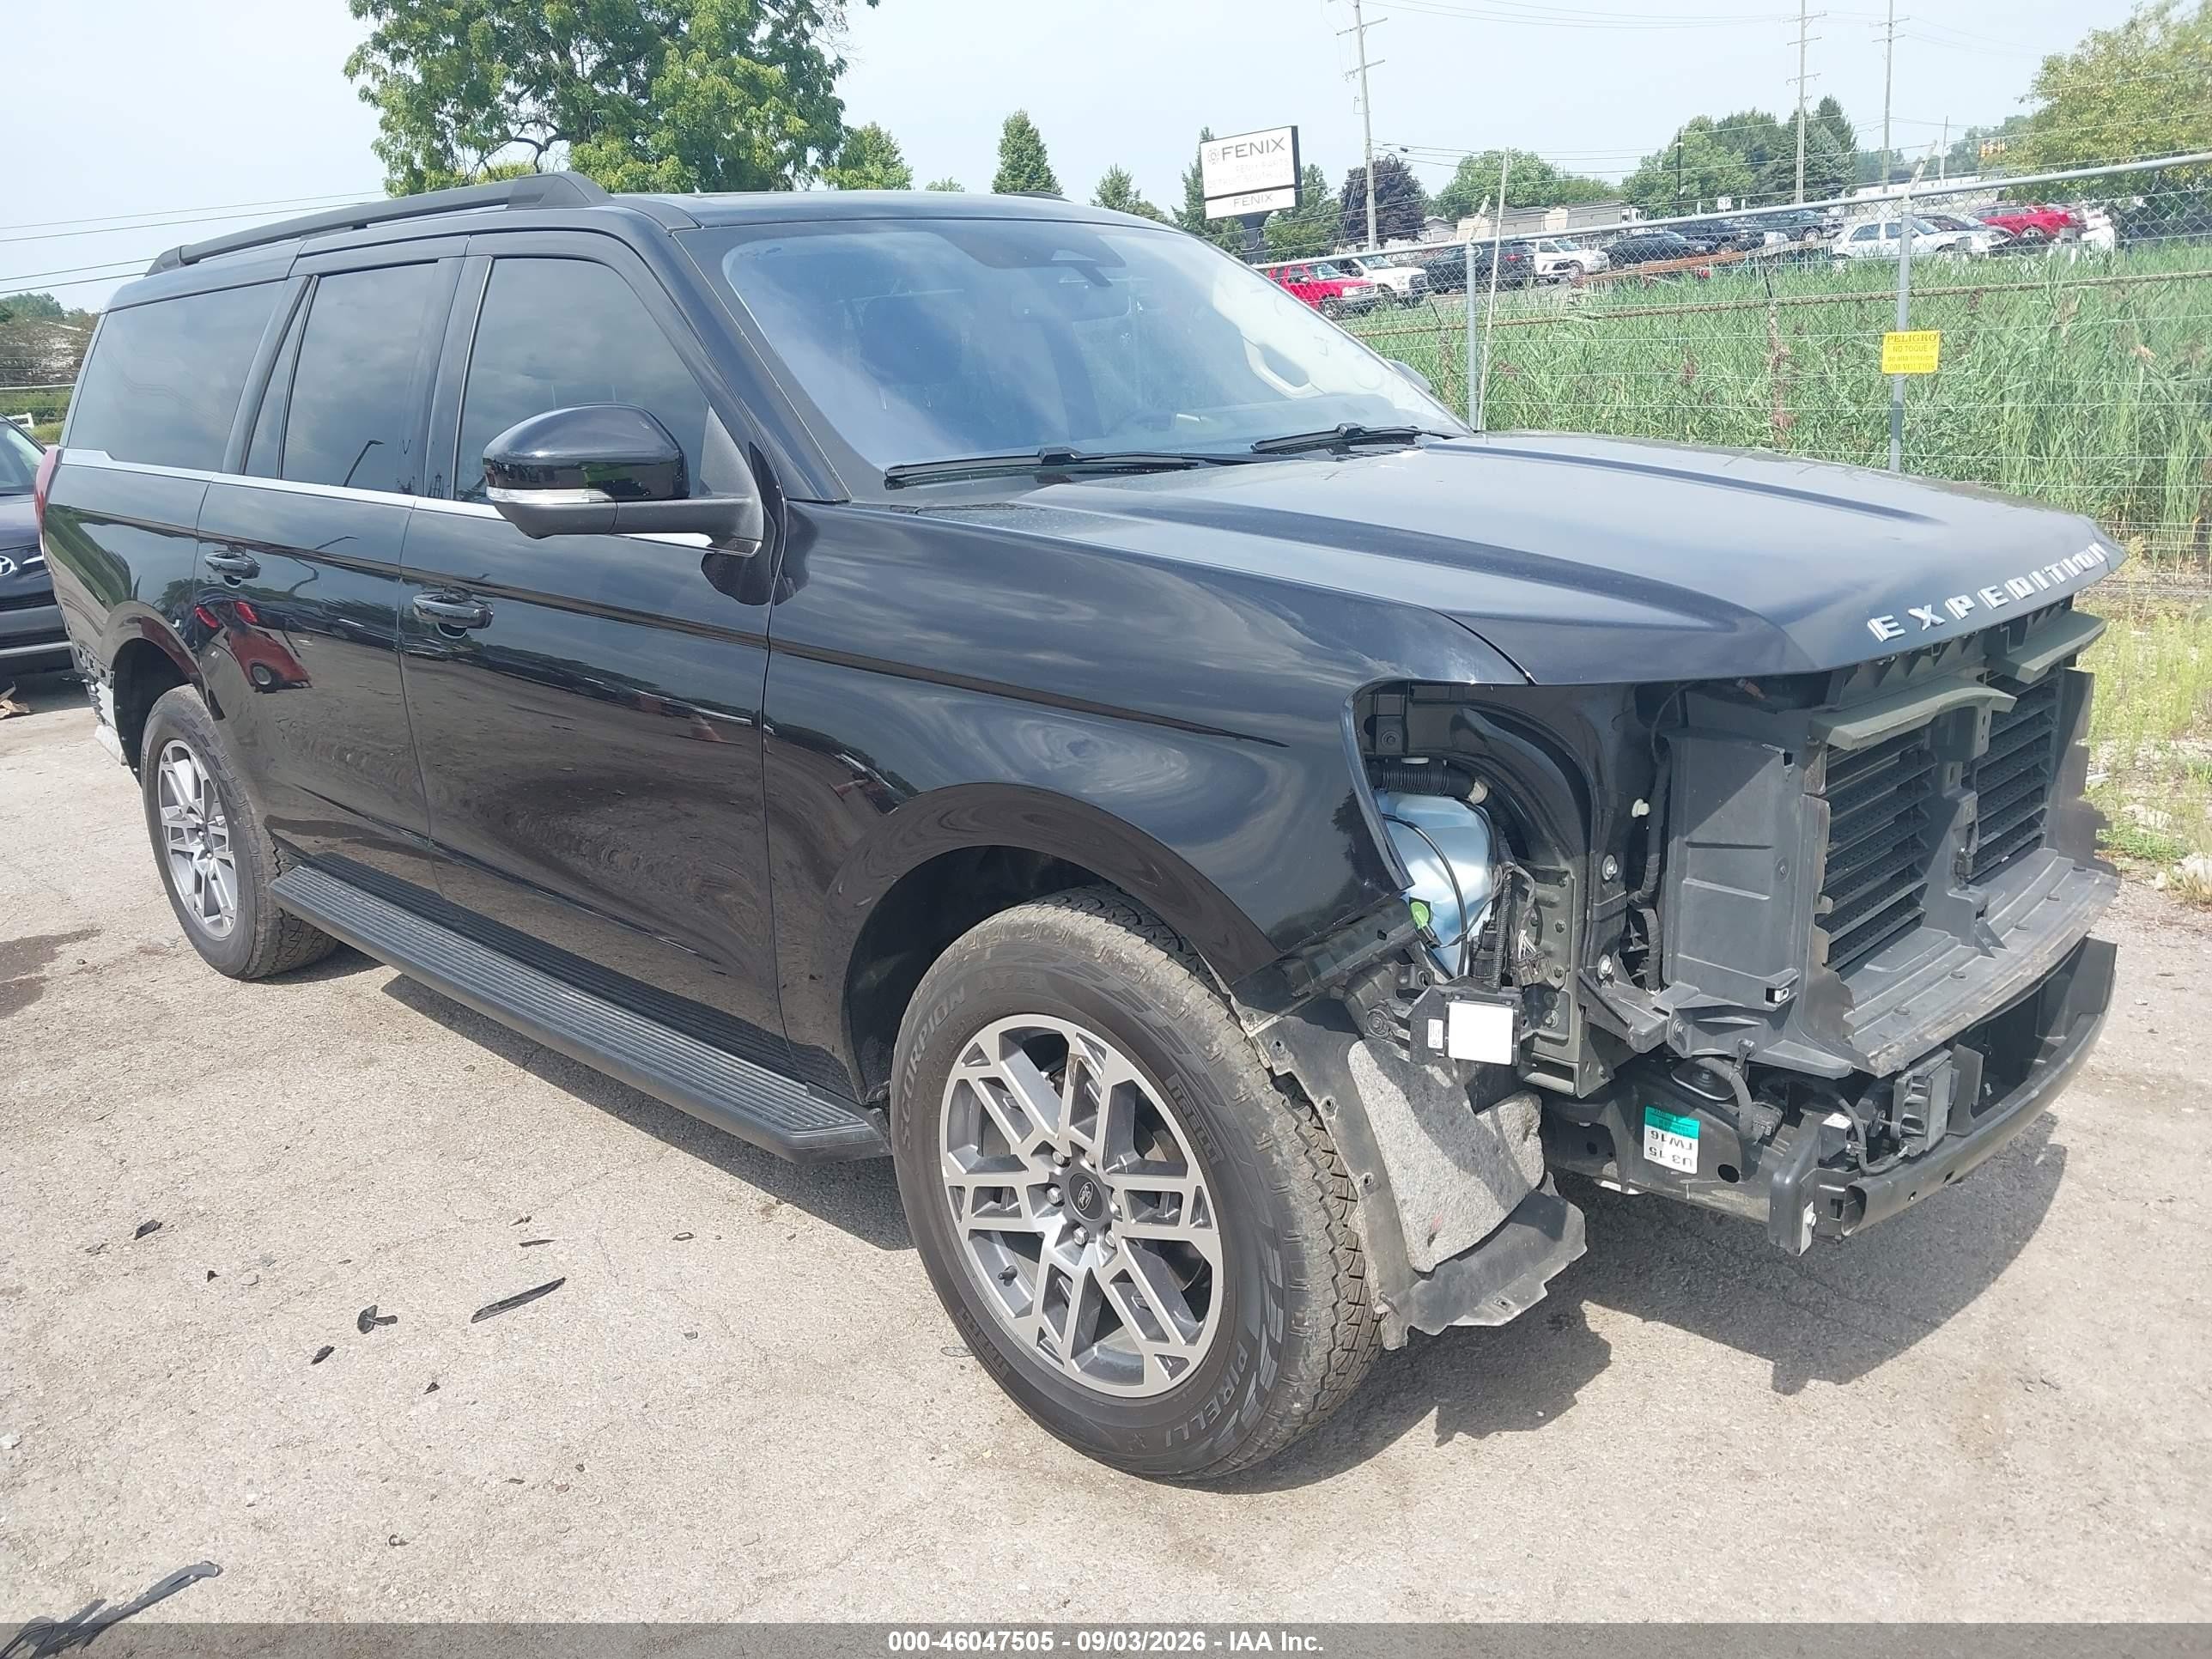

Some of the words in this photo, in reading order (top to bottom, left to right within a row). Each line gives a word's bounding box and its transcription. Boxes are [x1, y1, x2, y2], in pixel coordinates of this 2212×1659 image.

[1222, 137, 1285, 161] FENIX
[1233, 193, 1273, 208] FENIX
[1887, 334, 1937, 343] PELIGRO
[1867, 541, 2110, 642] EXPEDITION
[900, 984, 965, 1151] SCORPION
[1650, 1130, 1667, 1142] 16
[1165, 1340, 1249, 1448] PIRELLI
